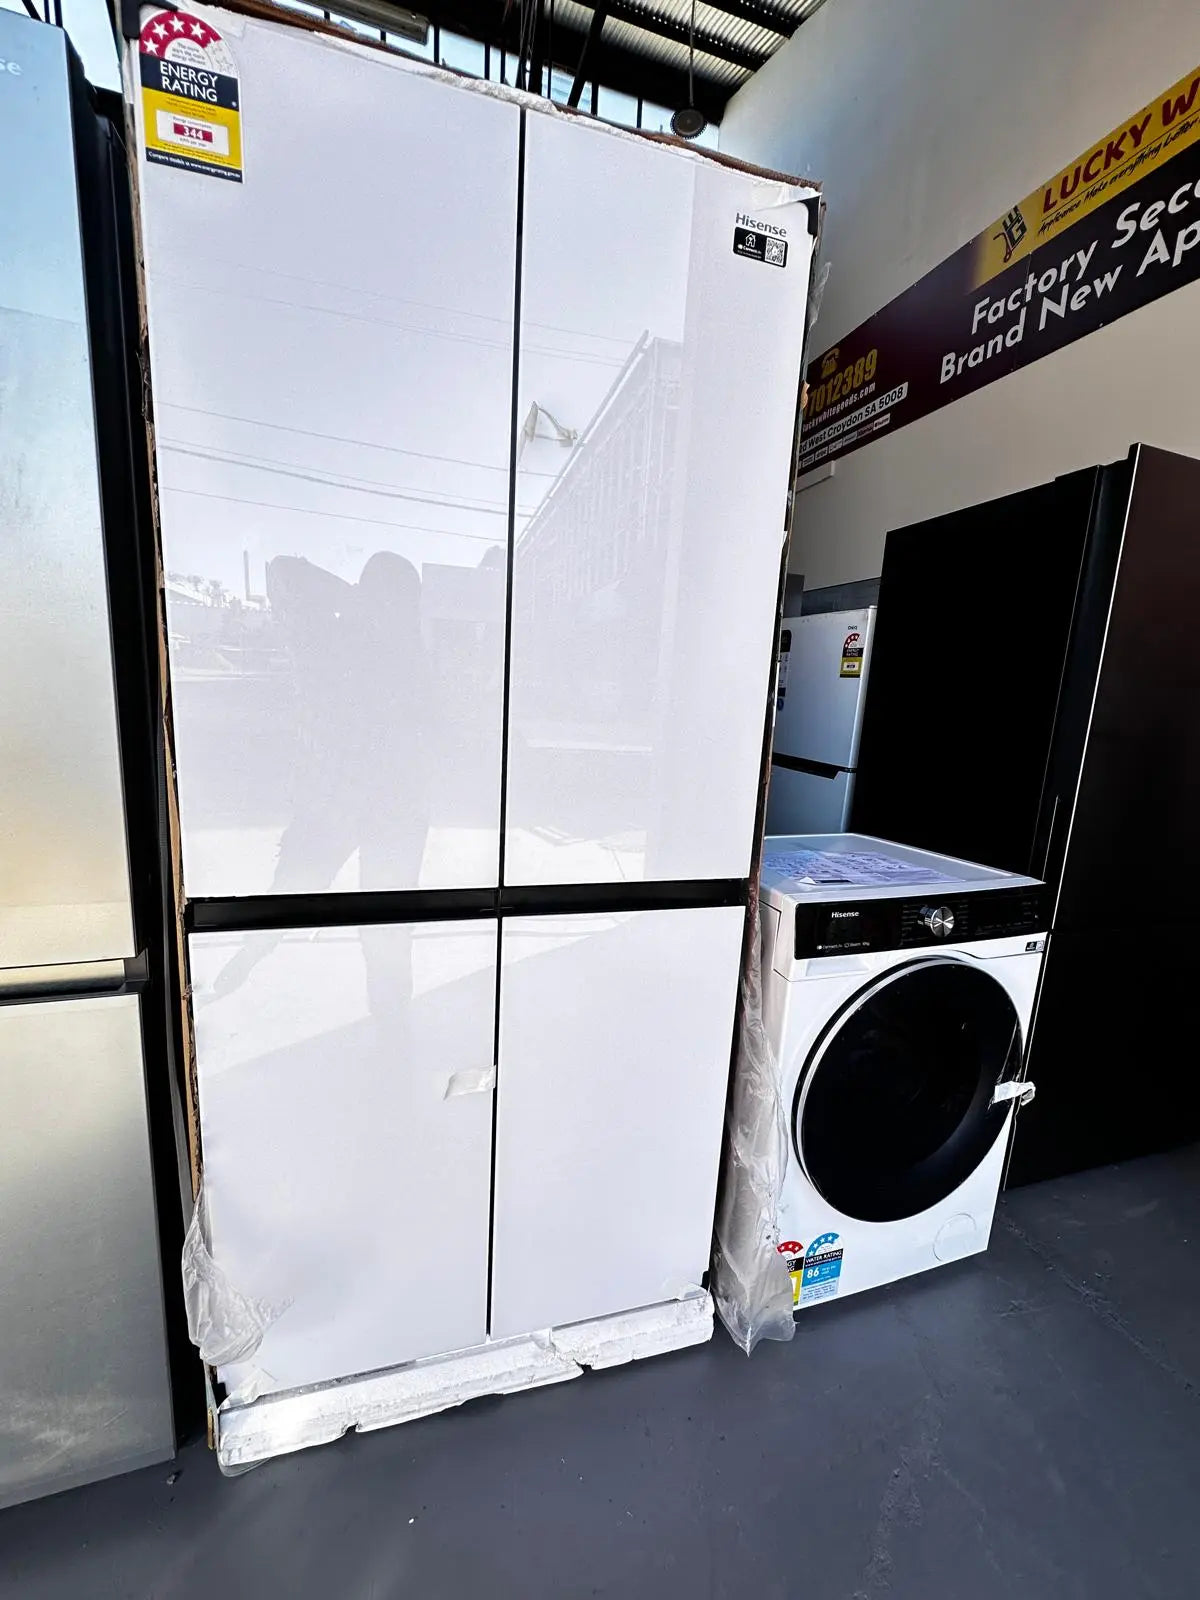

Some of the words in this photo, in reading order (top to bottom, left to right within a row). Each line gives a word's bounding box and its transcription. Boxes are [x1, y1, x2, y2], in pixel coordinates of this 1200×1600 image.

[160, 61, 218, 87] ENERGY
[162, 76, 218, 102] RATING
[183, 127, 204, 140] 344
[1043, 113, 1152, 214] LUCKY
[1161, 76, 1200, 127] W
[1109, 140, 1163, 186] everything
[735, 212, 787, 238] Hisense
[971, 240, 1098, 335] Factory
[940, 307, 1027, 384] Brand
[1038, 265, 1124, 331] New
[808, 432, 827, 448] West
[827, 412, 863, 438] Croydon
[865, 403, 876, 417] SA
[879, 386, 904, 409] 5008
[805, 1255, 822, 1264] WATER
[823, 1250, 842, 1259] RATING
[807, 1267, 820, 1278] 86
